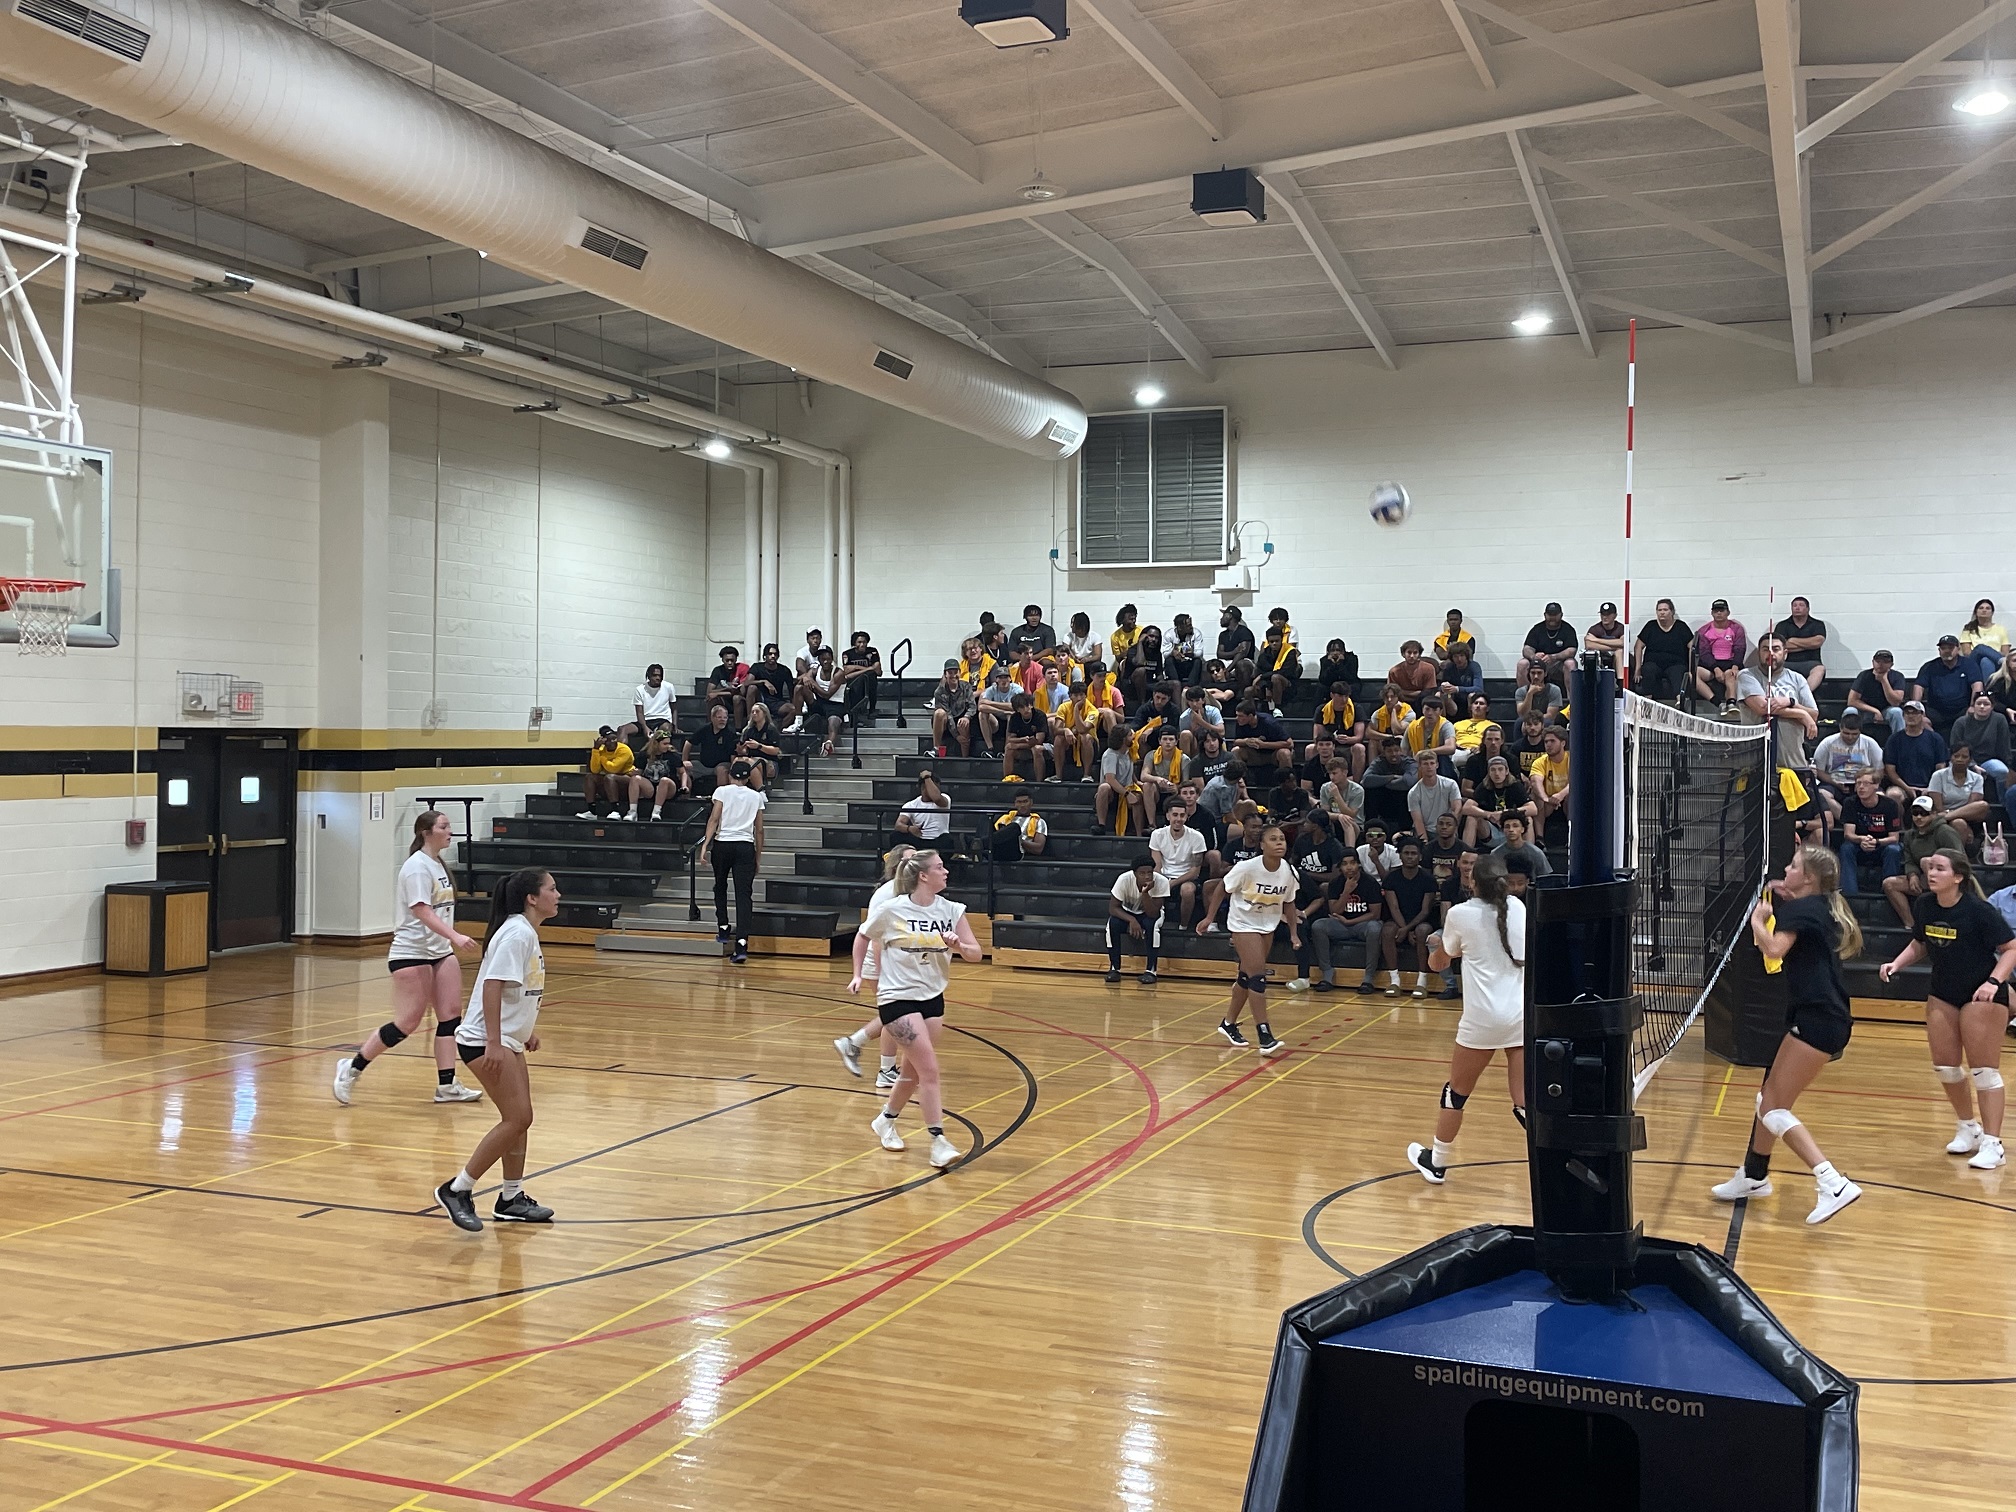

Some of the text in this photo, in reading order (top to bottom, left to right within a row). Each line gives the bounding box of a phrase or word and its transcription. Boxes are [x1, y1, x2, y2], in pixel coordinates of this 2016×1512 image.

[1256, 883, 1287, 896] TEAM
[1344, 902, 1368, 913] BITS
[907, 919, 953, 933] TEAM
[1414, 1364, 1704, 1417] spaldingequipment.com
